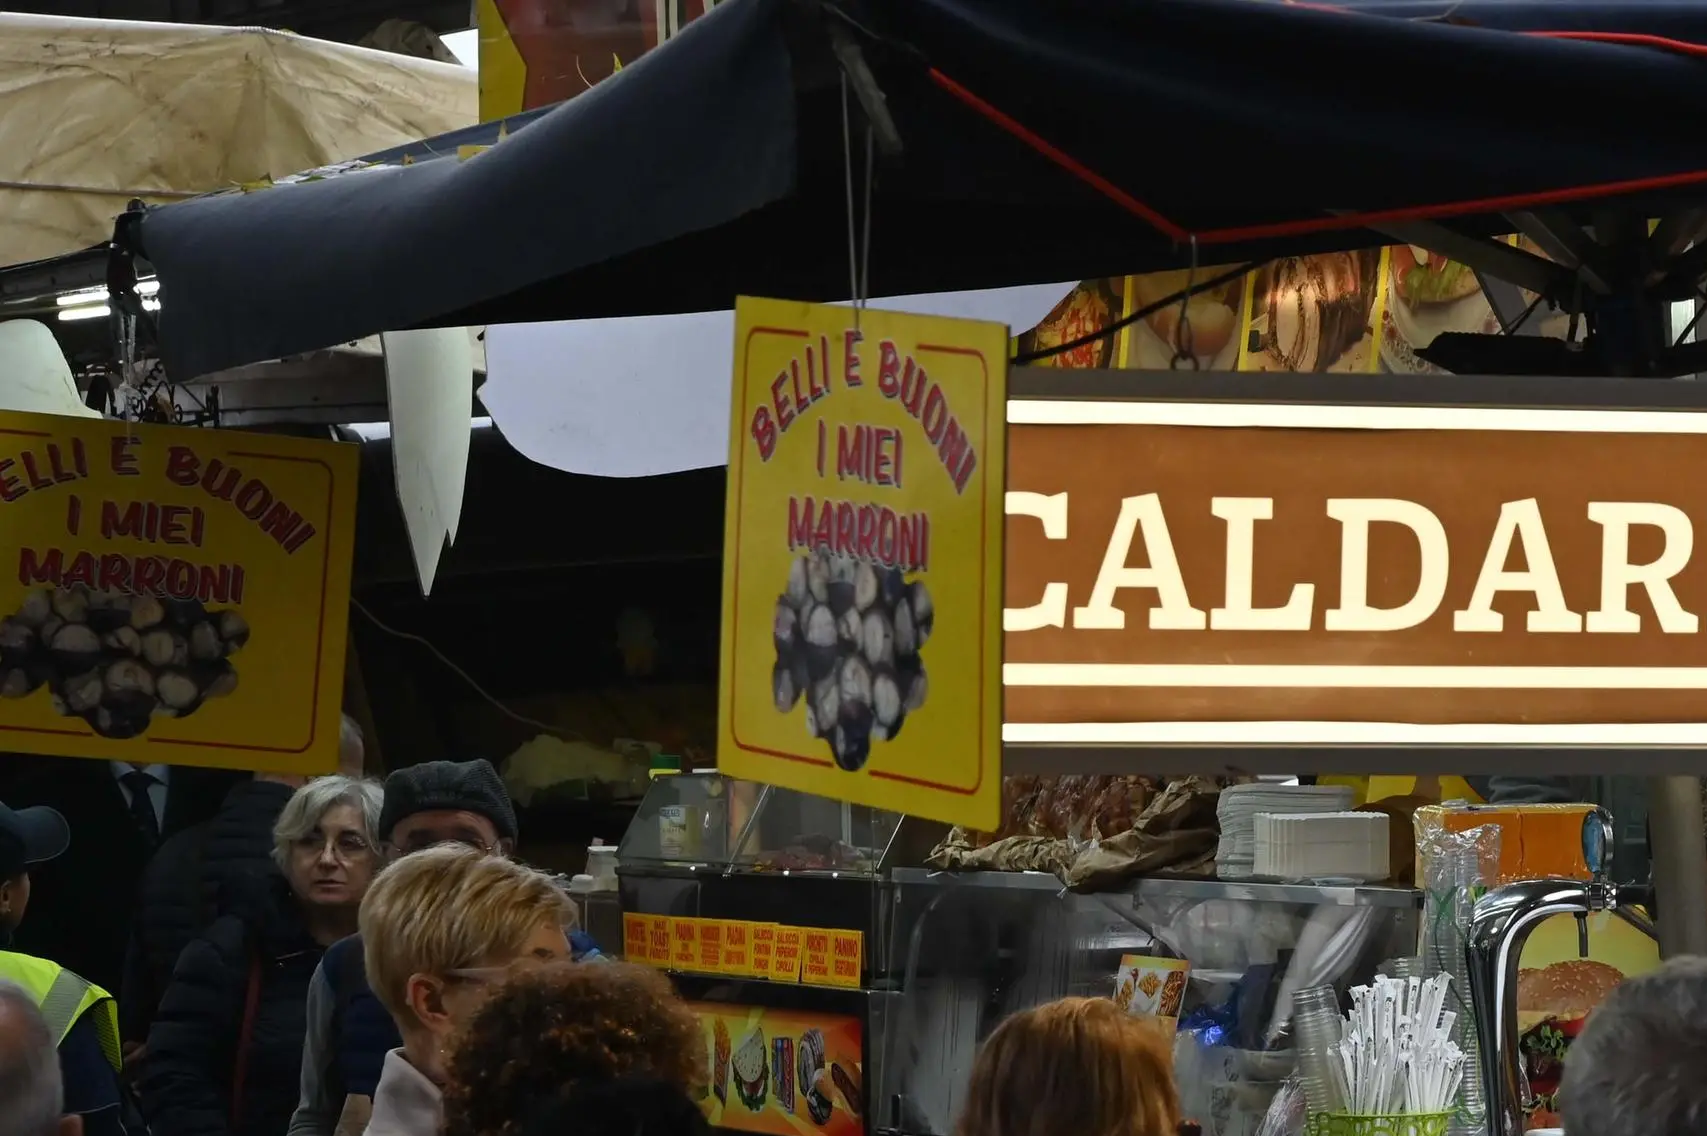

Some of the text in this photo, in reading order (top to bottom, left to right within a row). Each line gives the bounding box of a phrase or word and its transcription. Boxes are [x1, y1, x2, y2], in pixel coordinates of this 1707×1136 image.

[752, 330, 977, 495] BELLI E BUONI
[816, 417, 903, 489] I MIEI
[66, 494, 206, 547] I MIEI
[110, 436, 144, 475] E
[165, 446, 316, 555] BUONI
[787, 496, 930, 573] MARRONI
[18, 547, 245, 604] MARRONI
